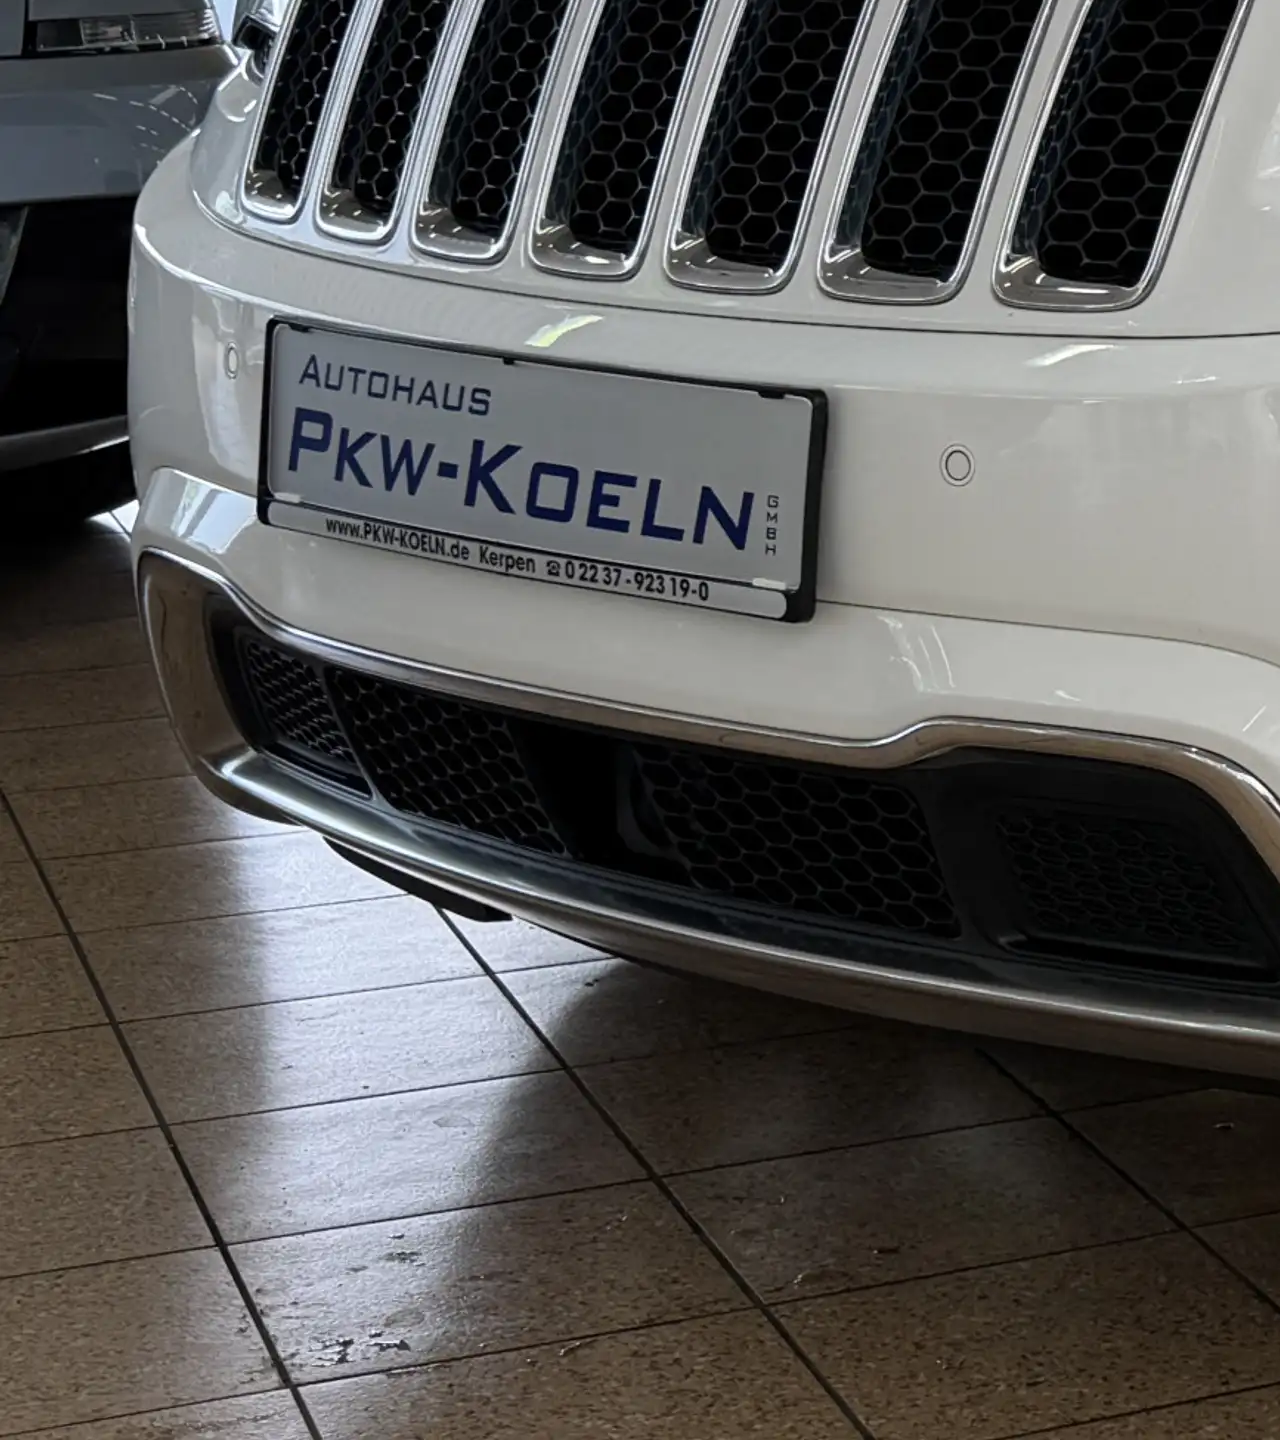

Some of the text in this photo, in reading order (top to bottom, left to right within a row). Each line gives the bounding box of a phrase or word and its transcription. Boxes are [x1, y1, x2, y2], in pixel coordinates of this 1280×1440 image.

[299, 354, 492, 416] AUTOHAUS
[288, 406, 755, 550] PKW-KOELN
[326, 517, 470, 560] www.PKW-KOELN.de
[479, 545, 536, 573] Kerpen
